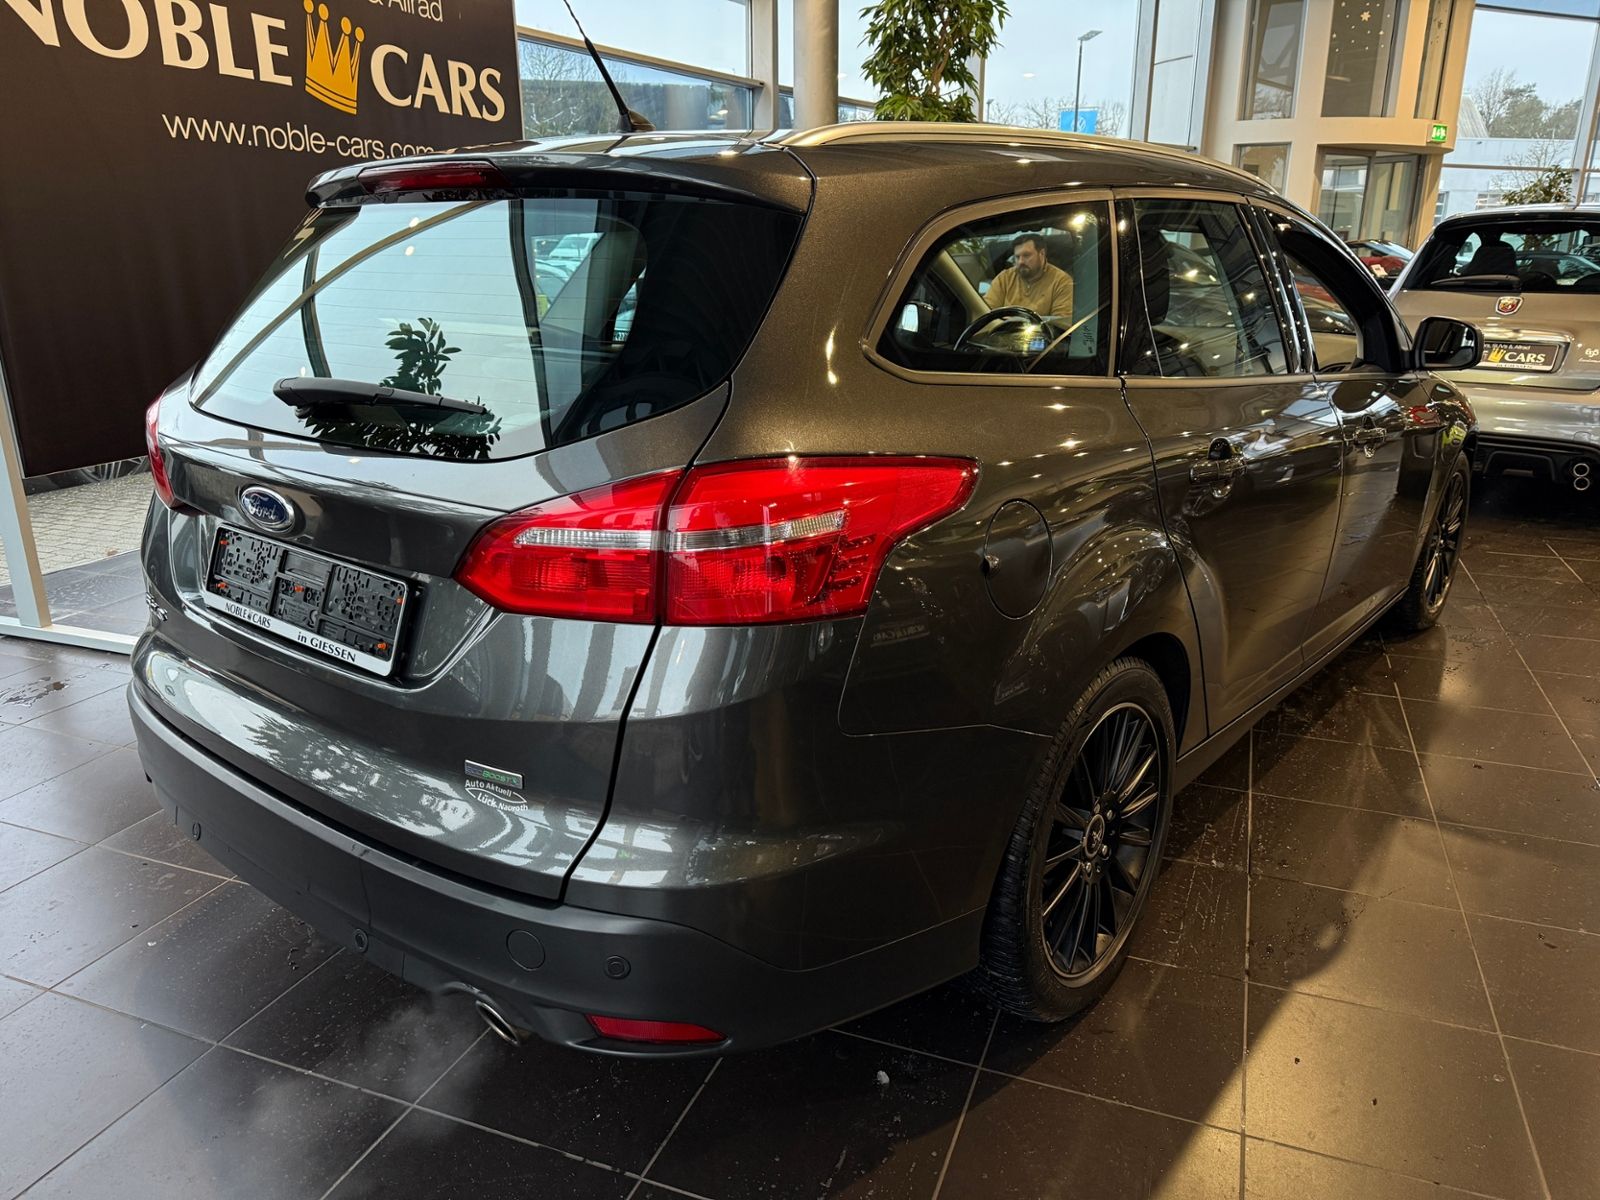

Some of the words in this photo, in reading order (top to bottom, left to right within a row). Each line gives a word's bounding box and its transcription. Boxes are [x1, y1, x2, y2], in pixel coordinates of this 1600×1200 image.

[370, 44, 506, 122] CARS
[1504, 351, 1546, 363] CARS
[249, 493, 277, 520] Ford
[225, 602, 247, 618] NOBLE
[252, 612, 271, 629] CARS
[297, 631, 307, 643] in
[310, 637, 356, 663] GIESSEN
[464, 779, 485, 788] Auto
[485, 783, 512, 797] Aktuell
